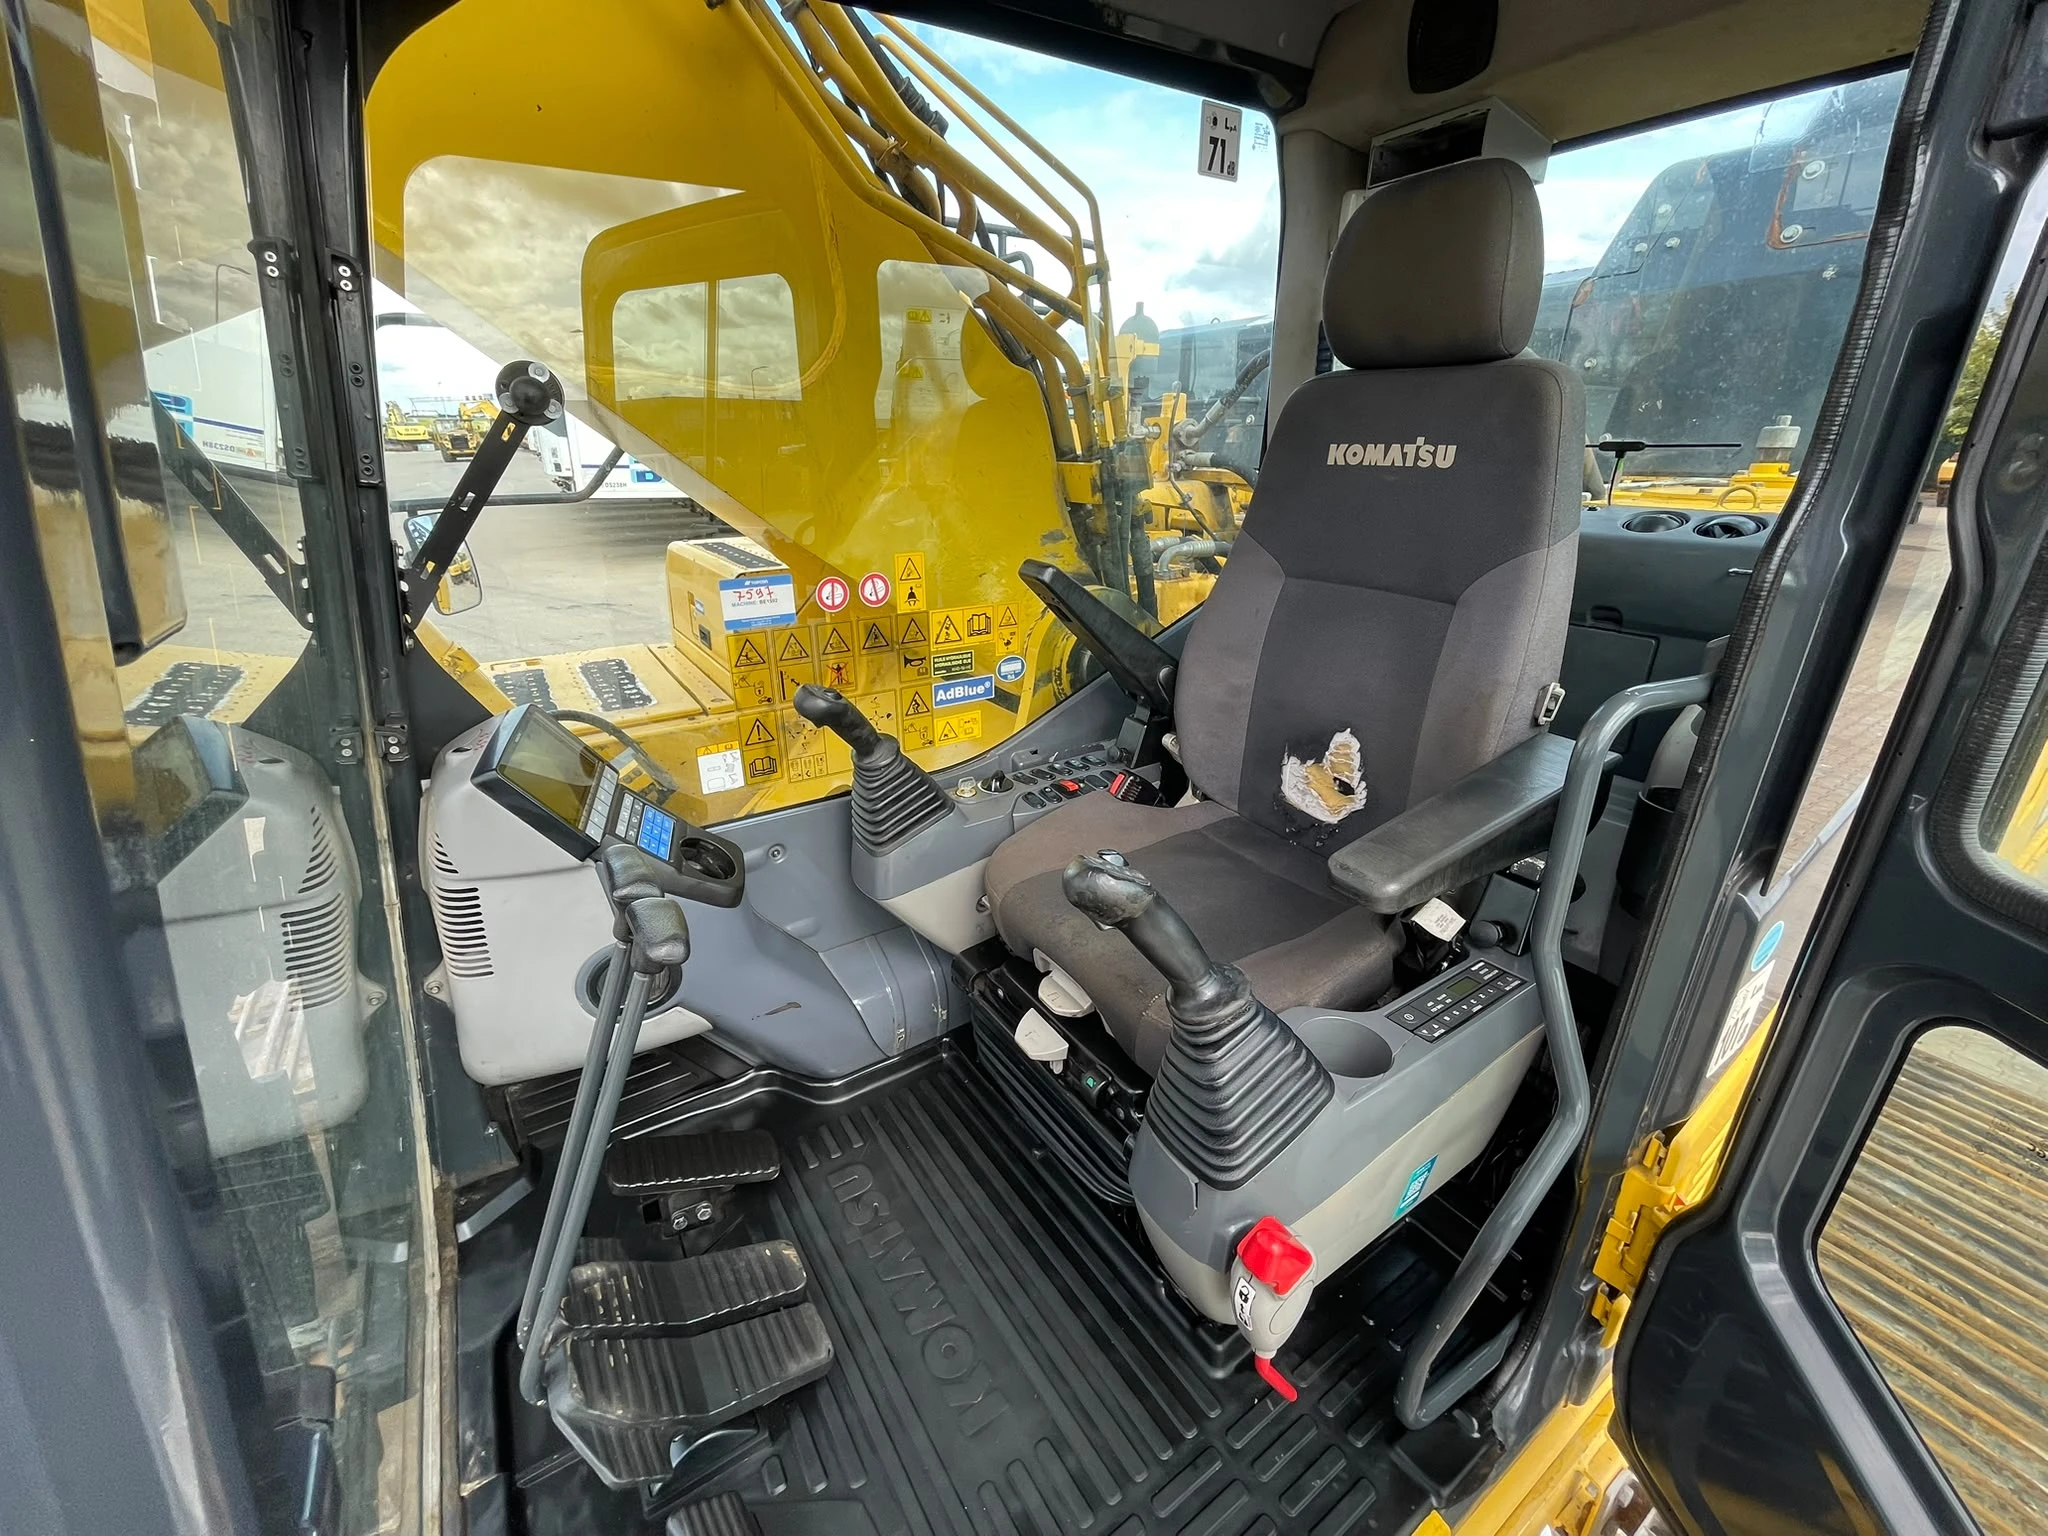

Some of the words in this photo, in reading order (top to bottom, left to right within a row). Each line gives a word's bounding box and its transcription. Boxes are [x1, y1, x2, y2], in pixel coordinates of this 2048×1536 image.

[1207, 135, 1227, 174] 71
[1326, 436, 1457, 469] KOMATSU
[827, 1163, 1009, 1437] KOMATSU
